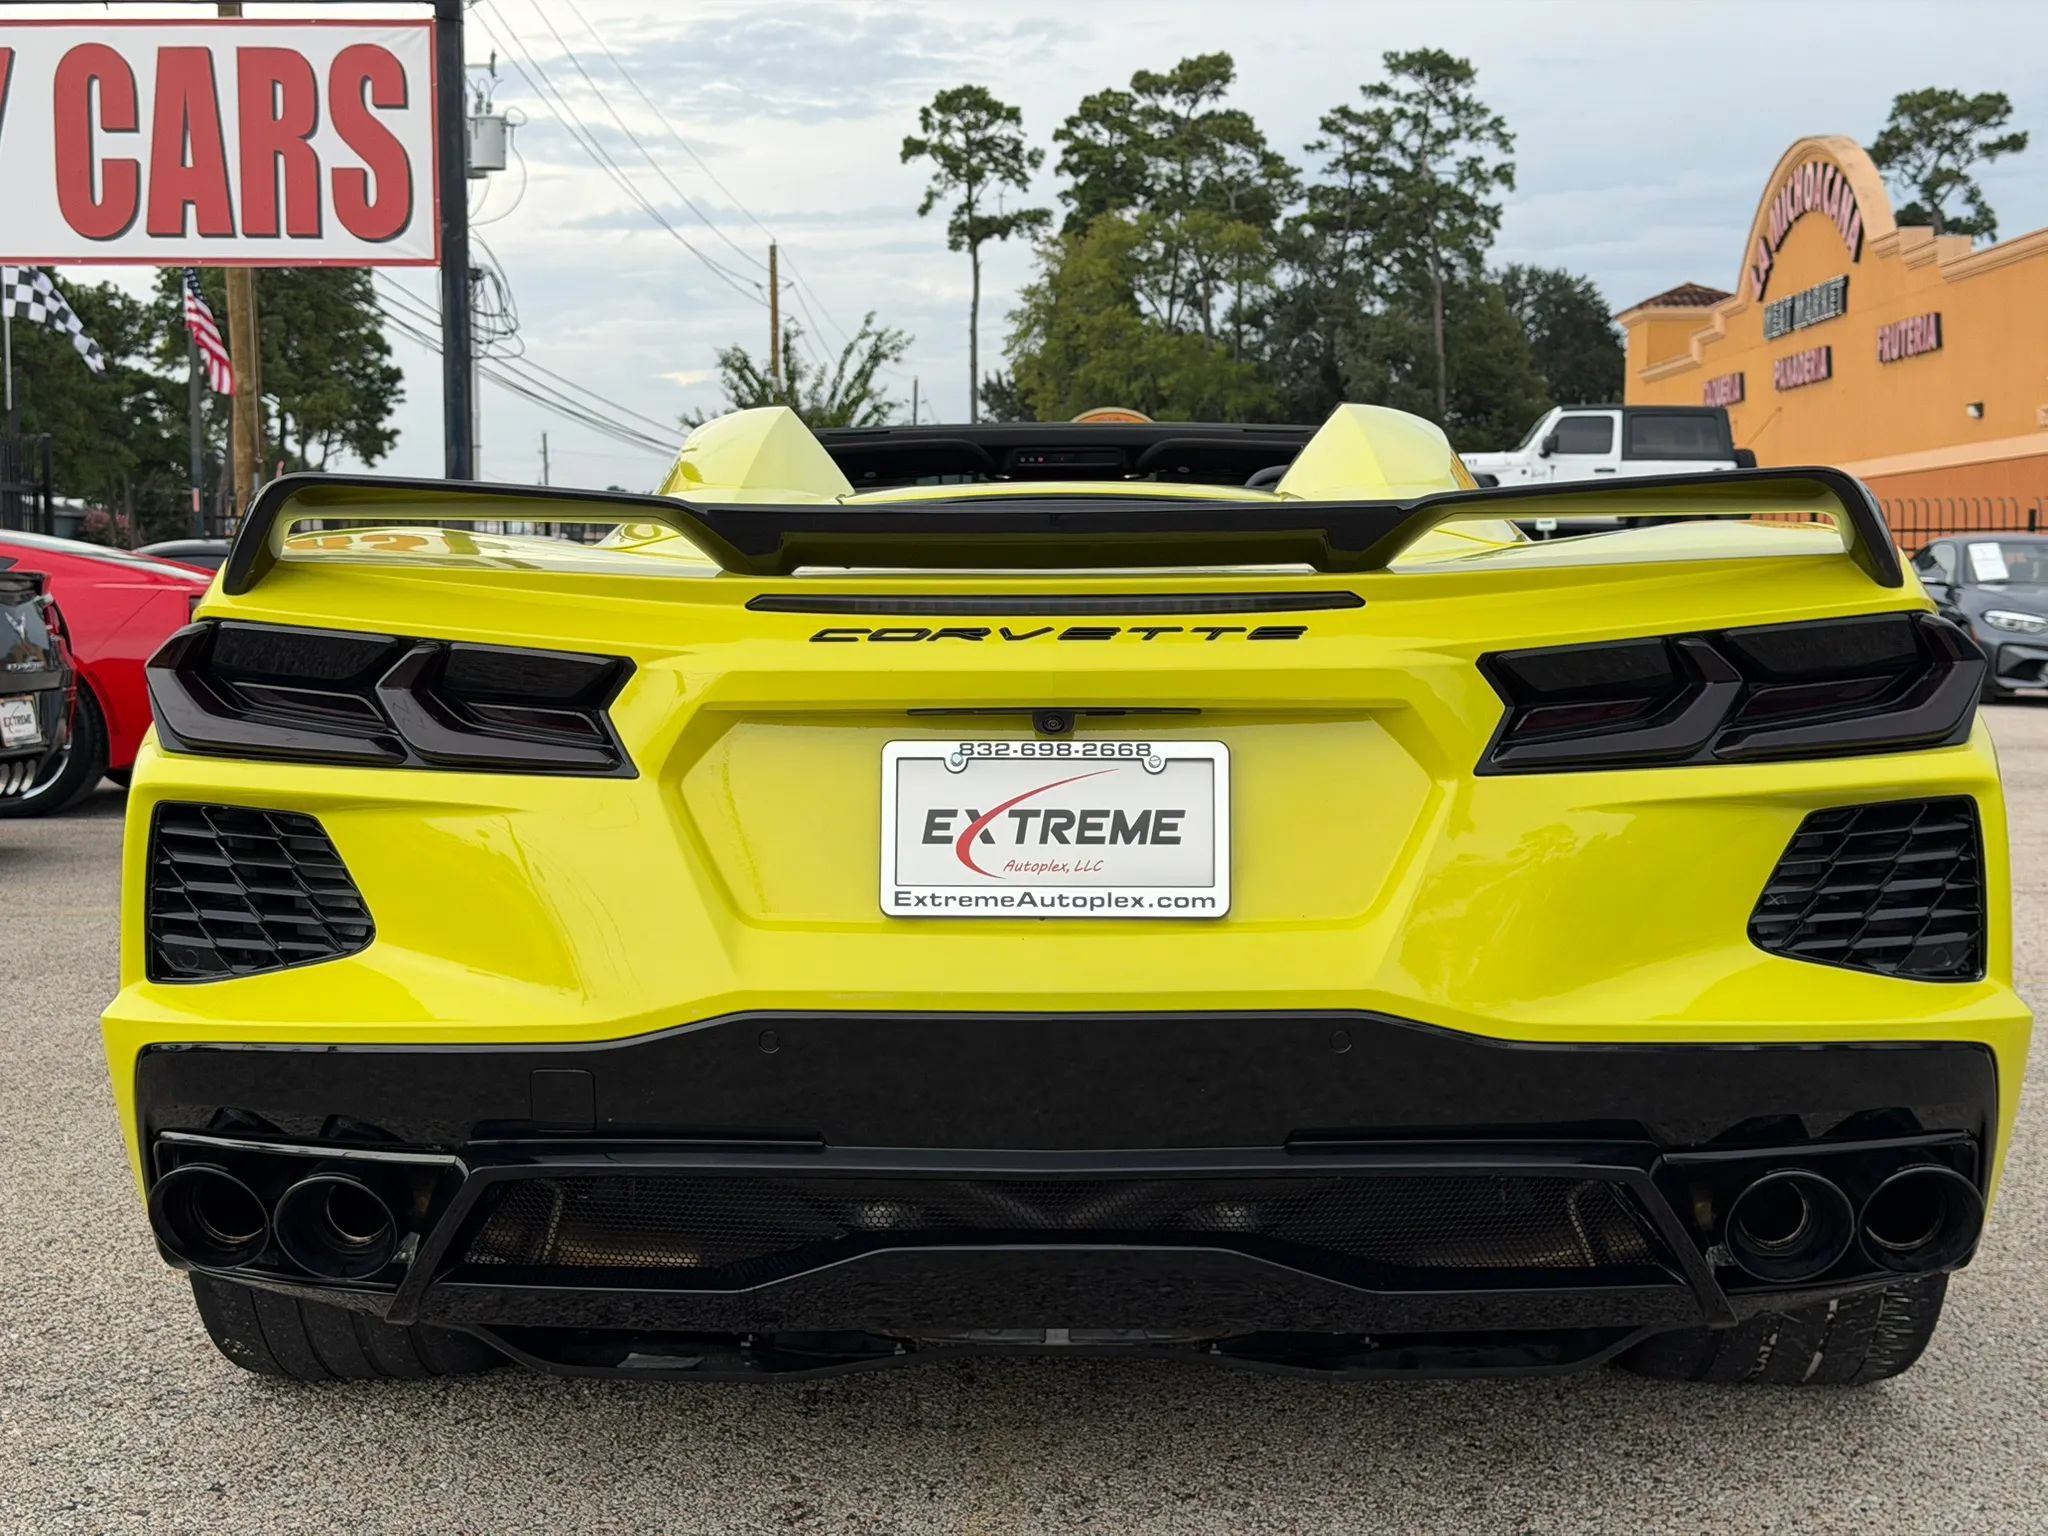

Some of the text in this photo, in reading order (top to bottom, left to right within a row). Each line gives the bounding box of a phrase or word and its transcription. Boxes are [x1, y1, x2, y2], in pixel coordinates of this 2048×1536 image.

[53, 42, 414, 242] CARS
[1769, 161, 1863, 262] MICHOACANA
[1764, 275, 1848, 340] MEAT MARKET
[1877, 312, 1942, 363] FRUTERIA
[809, 626, 1309, 643] CORVETTE
[958, 743, 1152, 757] 832-698-2668
[921, 809, 1186, 845] EXTREME
[1002, 860, 1104, 876] Autoplex, LLC
[893, 891, 1216, 911] ExtremeAutoplex.com
